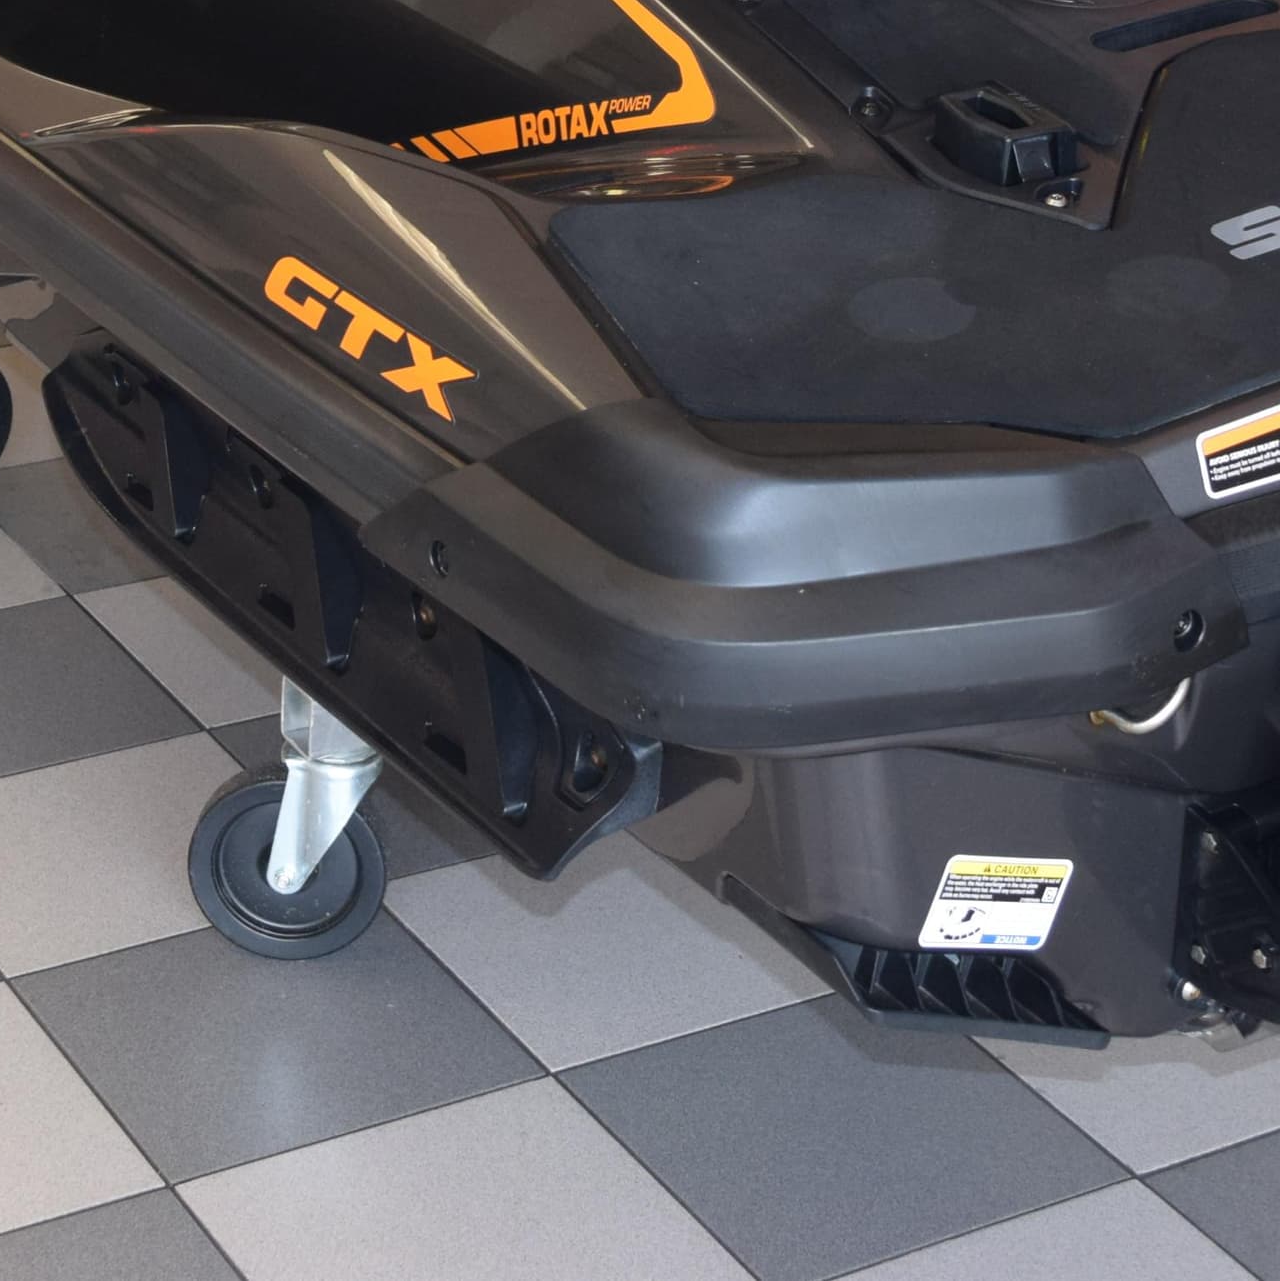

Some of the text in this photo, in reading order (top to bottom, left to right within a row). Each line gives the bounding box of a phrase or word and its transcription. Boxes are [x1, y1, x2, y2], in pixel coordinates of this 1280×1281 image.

[520, 94, 652, 148] ROTAX POWER
[263, 255, 477, 422] GTX
[994, 864, 1040, 876] CAUTION
